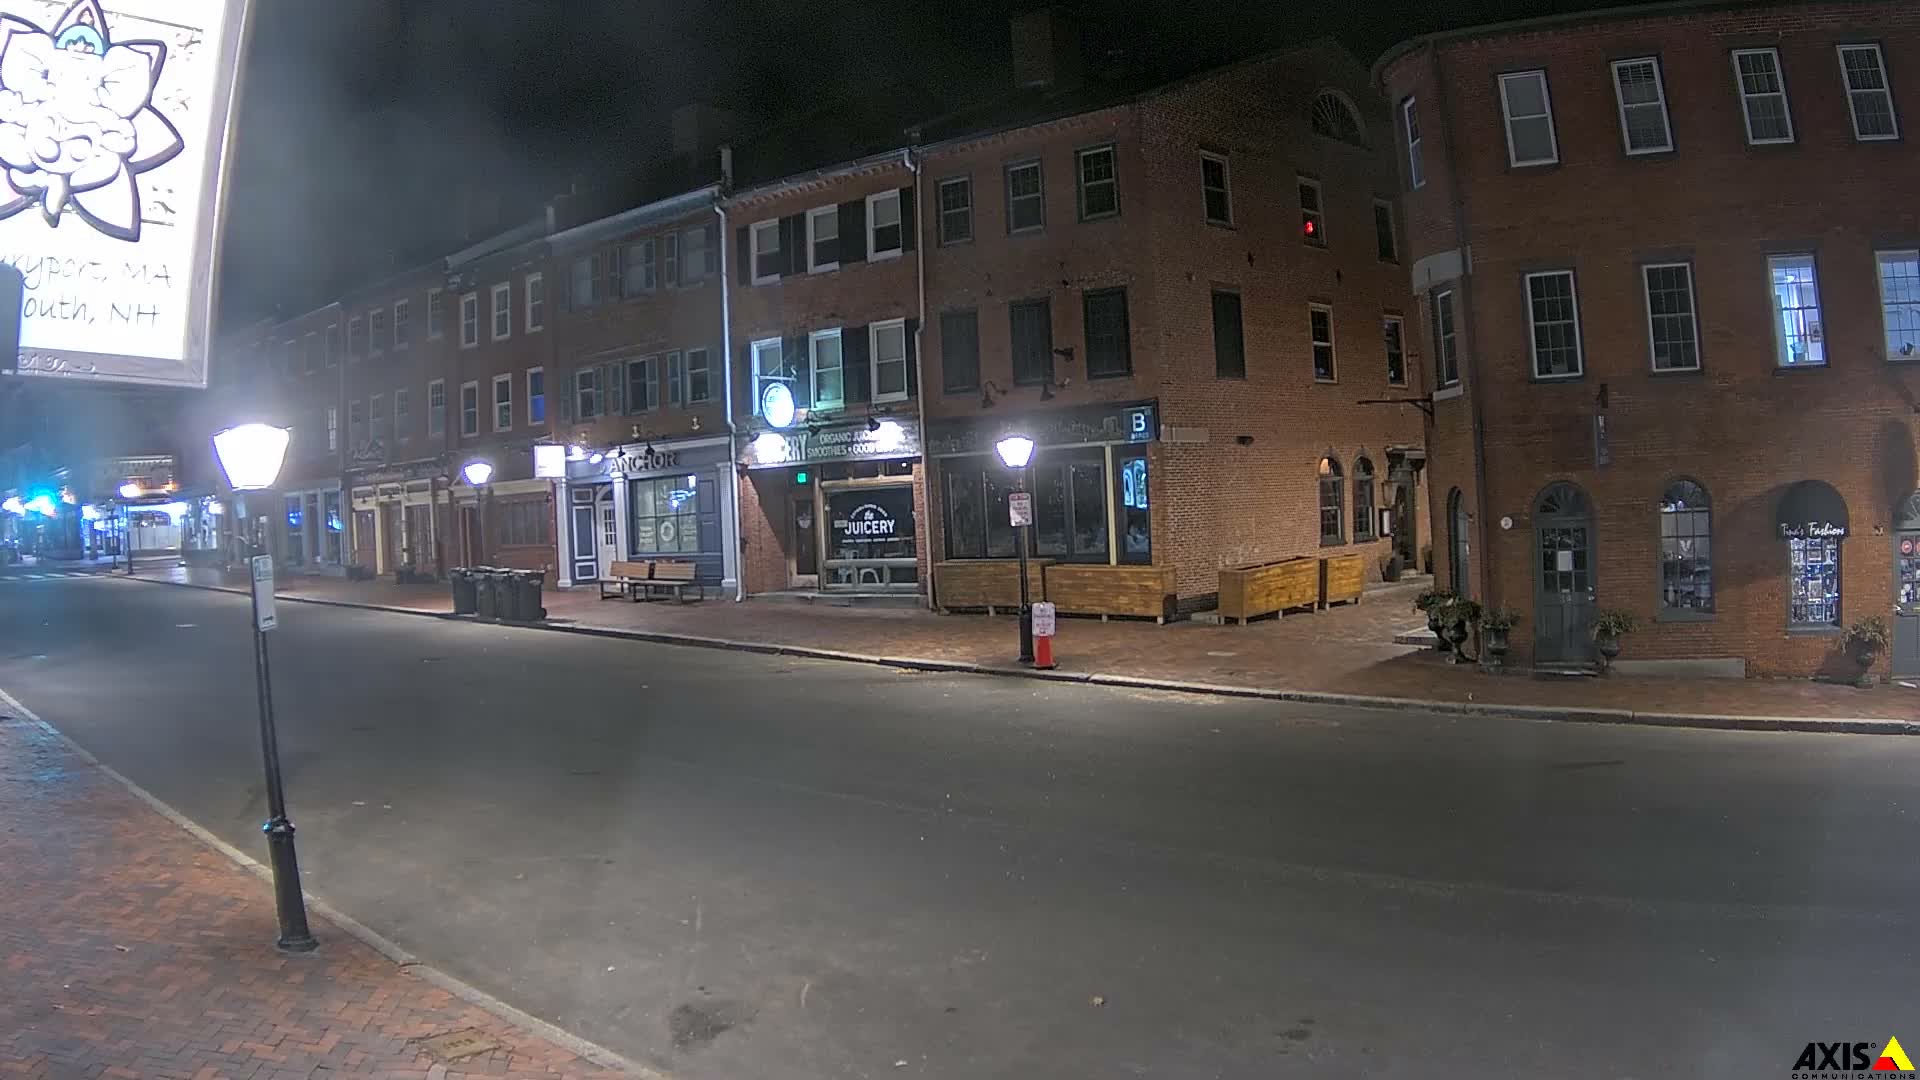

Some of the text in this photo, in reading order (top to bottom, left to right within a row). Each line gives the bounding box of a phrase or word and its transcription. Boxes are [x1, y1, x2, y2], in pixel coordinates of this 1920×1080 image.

[124, 262, 172, 288] MA
[23, 295, 161, 328] outh, NH
[1132, 412, 1145, 432] B
[820, 431, 851, 444] ORGANIC
[807, 444, 847, 458] SMOOTHIES
[609, 452, 681, 473] ANCHOR
[844, 519, 895, 535] JUICERY
